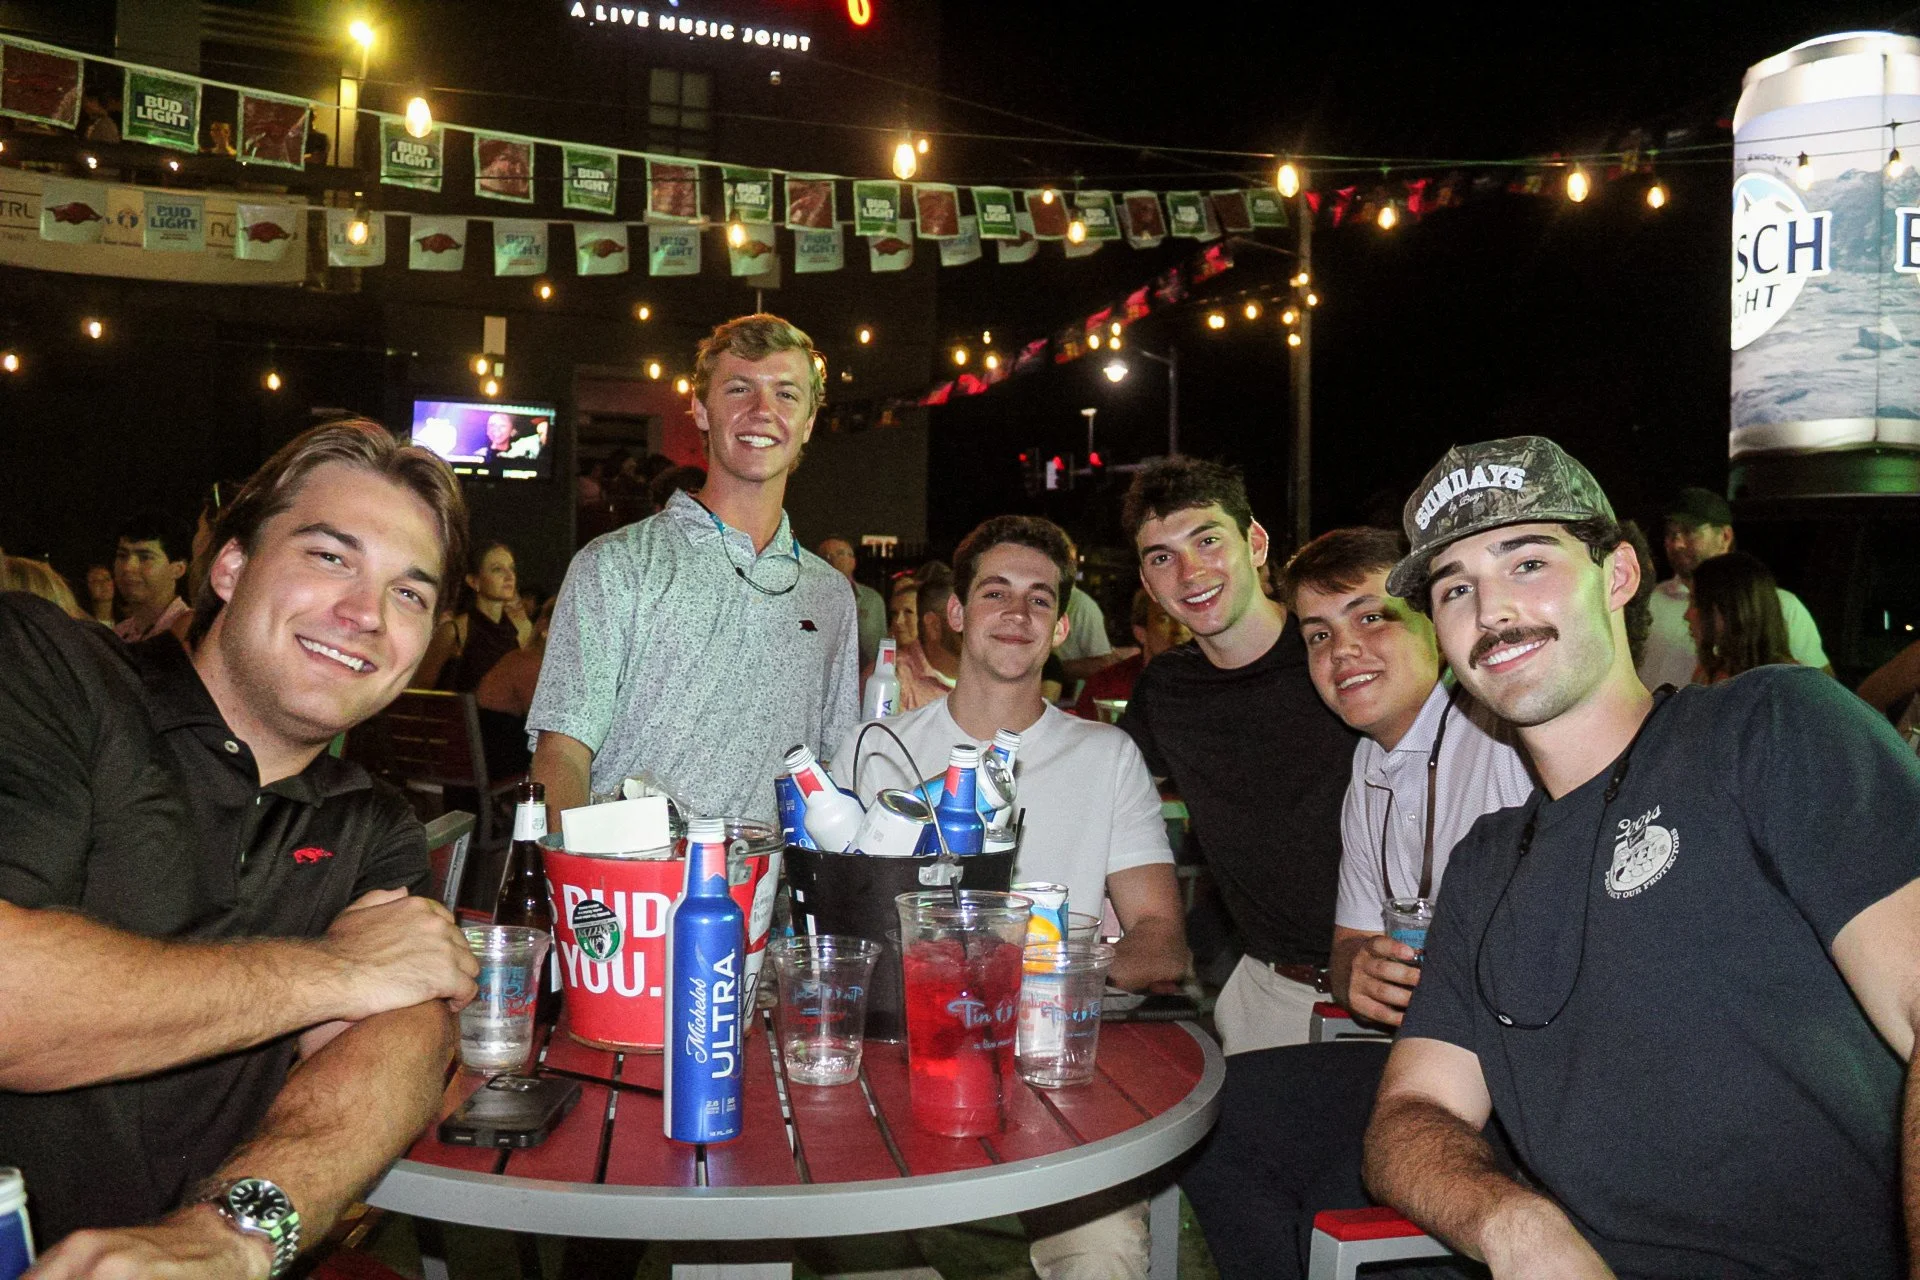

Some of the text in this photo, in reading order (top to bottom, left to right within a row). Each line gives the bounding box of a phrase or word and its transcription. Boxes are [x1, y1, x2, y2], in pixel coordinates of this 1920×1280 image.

[570, 1, 586, 18] A
[595, 4, 649, 28] LIVE
[659, 14, 735, 40] MUSIC
[136, 105, 189, 127] LIGHT
[144, 94, 183, 114] BUD
[391, 150, 434, 169] LIGHT
[397, 140, 429, 157] BUD
[573, 179, 610, 194] LIGHT
[150, 216, 198, 230] LIGHT
[156, 205, 192, 218] BUD
[1736, 216, 1824, 284] SCH
[1415, 464, 1526, 531] SUNDAYS
[1615, 804, 1662, 841] Coors
[1622, 886, 1642, 899] OUR
[1642, 827, 1680, 890] PROTECTORS
[562, 884, 683, 939] BUD
[561, 940, 662, 998] YOU.
[685, 976, 708, 1064] Michelob
[711, 953, 737, 1079] ULTRA
[946, 999, 993, 1029] Tin
